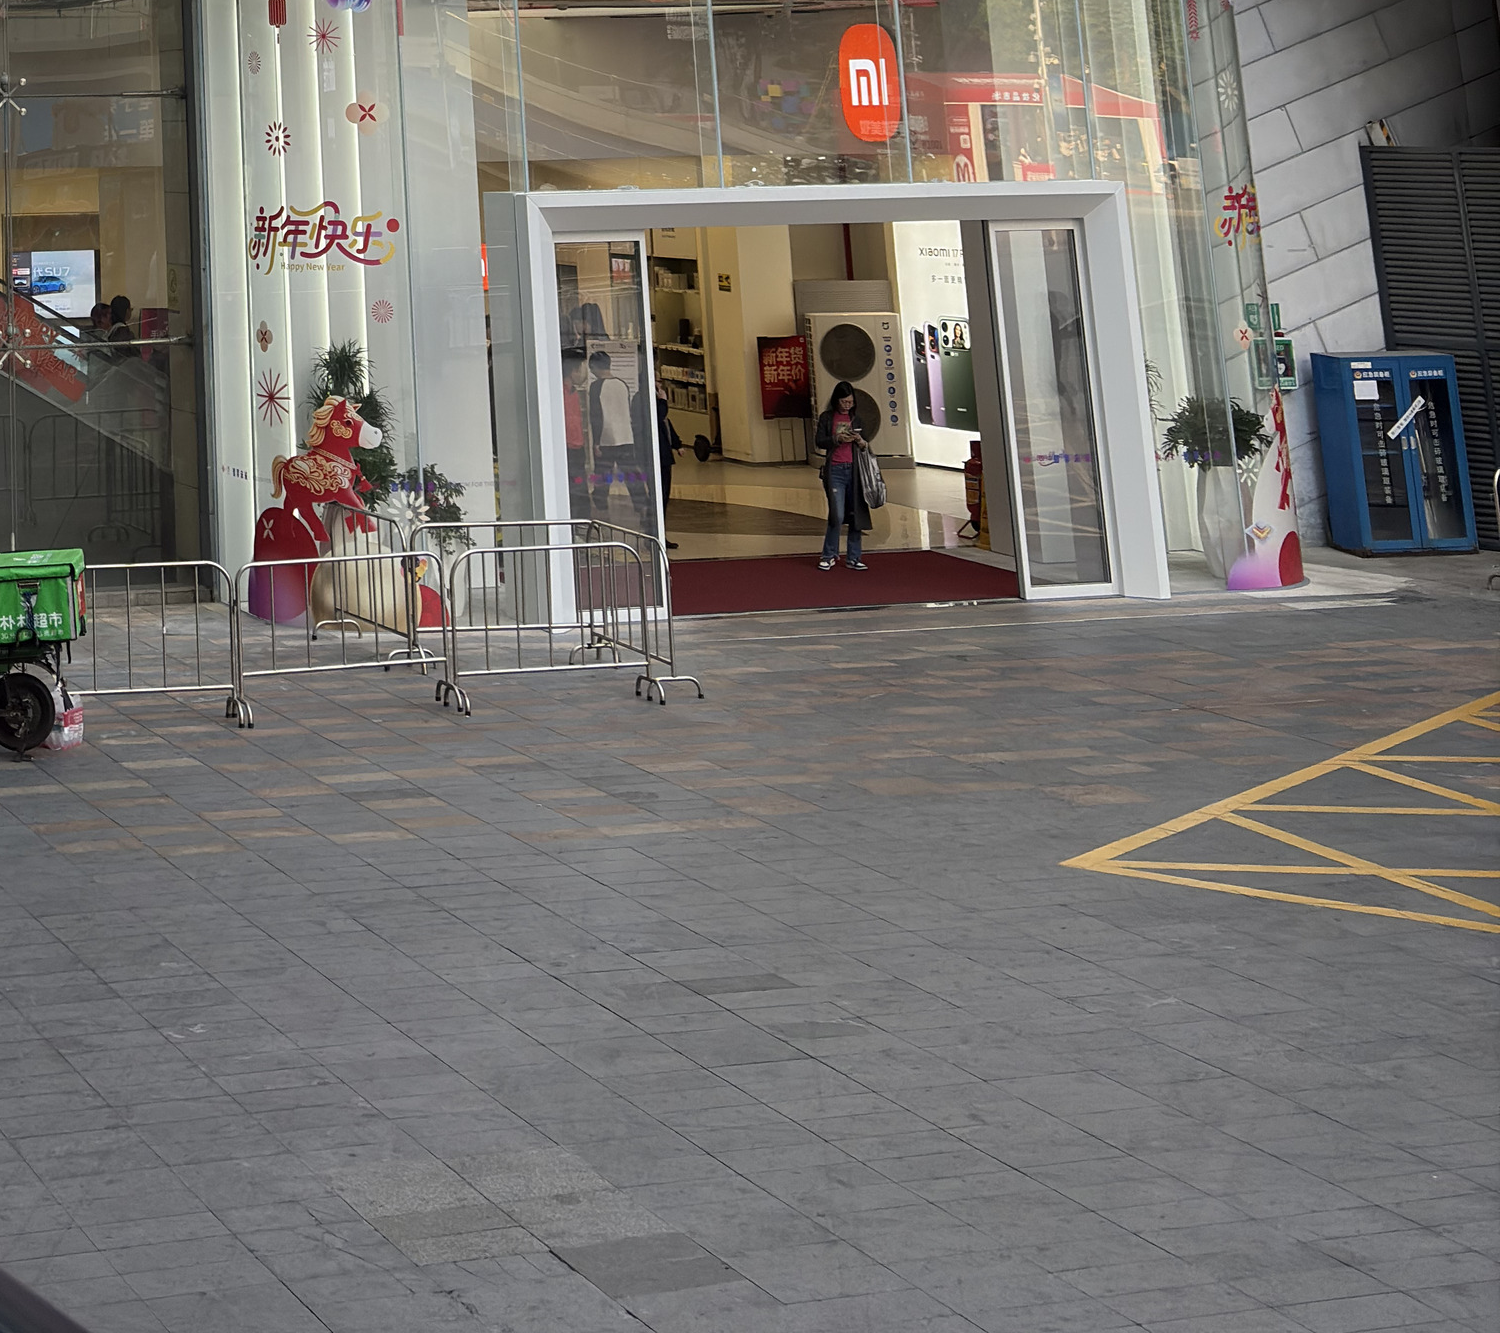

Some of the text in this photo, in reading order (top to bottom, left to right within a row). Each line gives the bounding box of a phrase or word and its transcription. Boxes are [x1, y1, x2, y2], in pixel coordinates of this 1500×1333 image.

[249, 201, 396, 275] 新年快乐
[280, 261, 346, 273] Happy New Year
